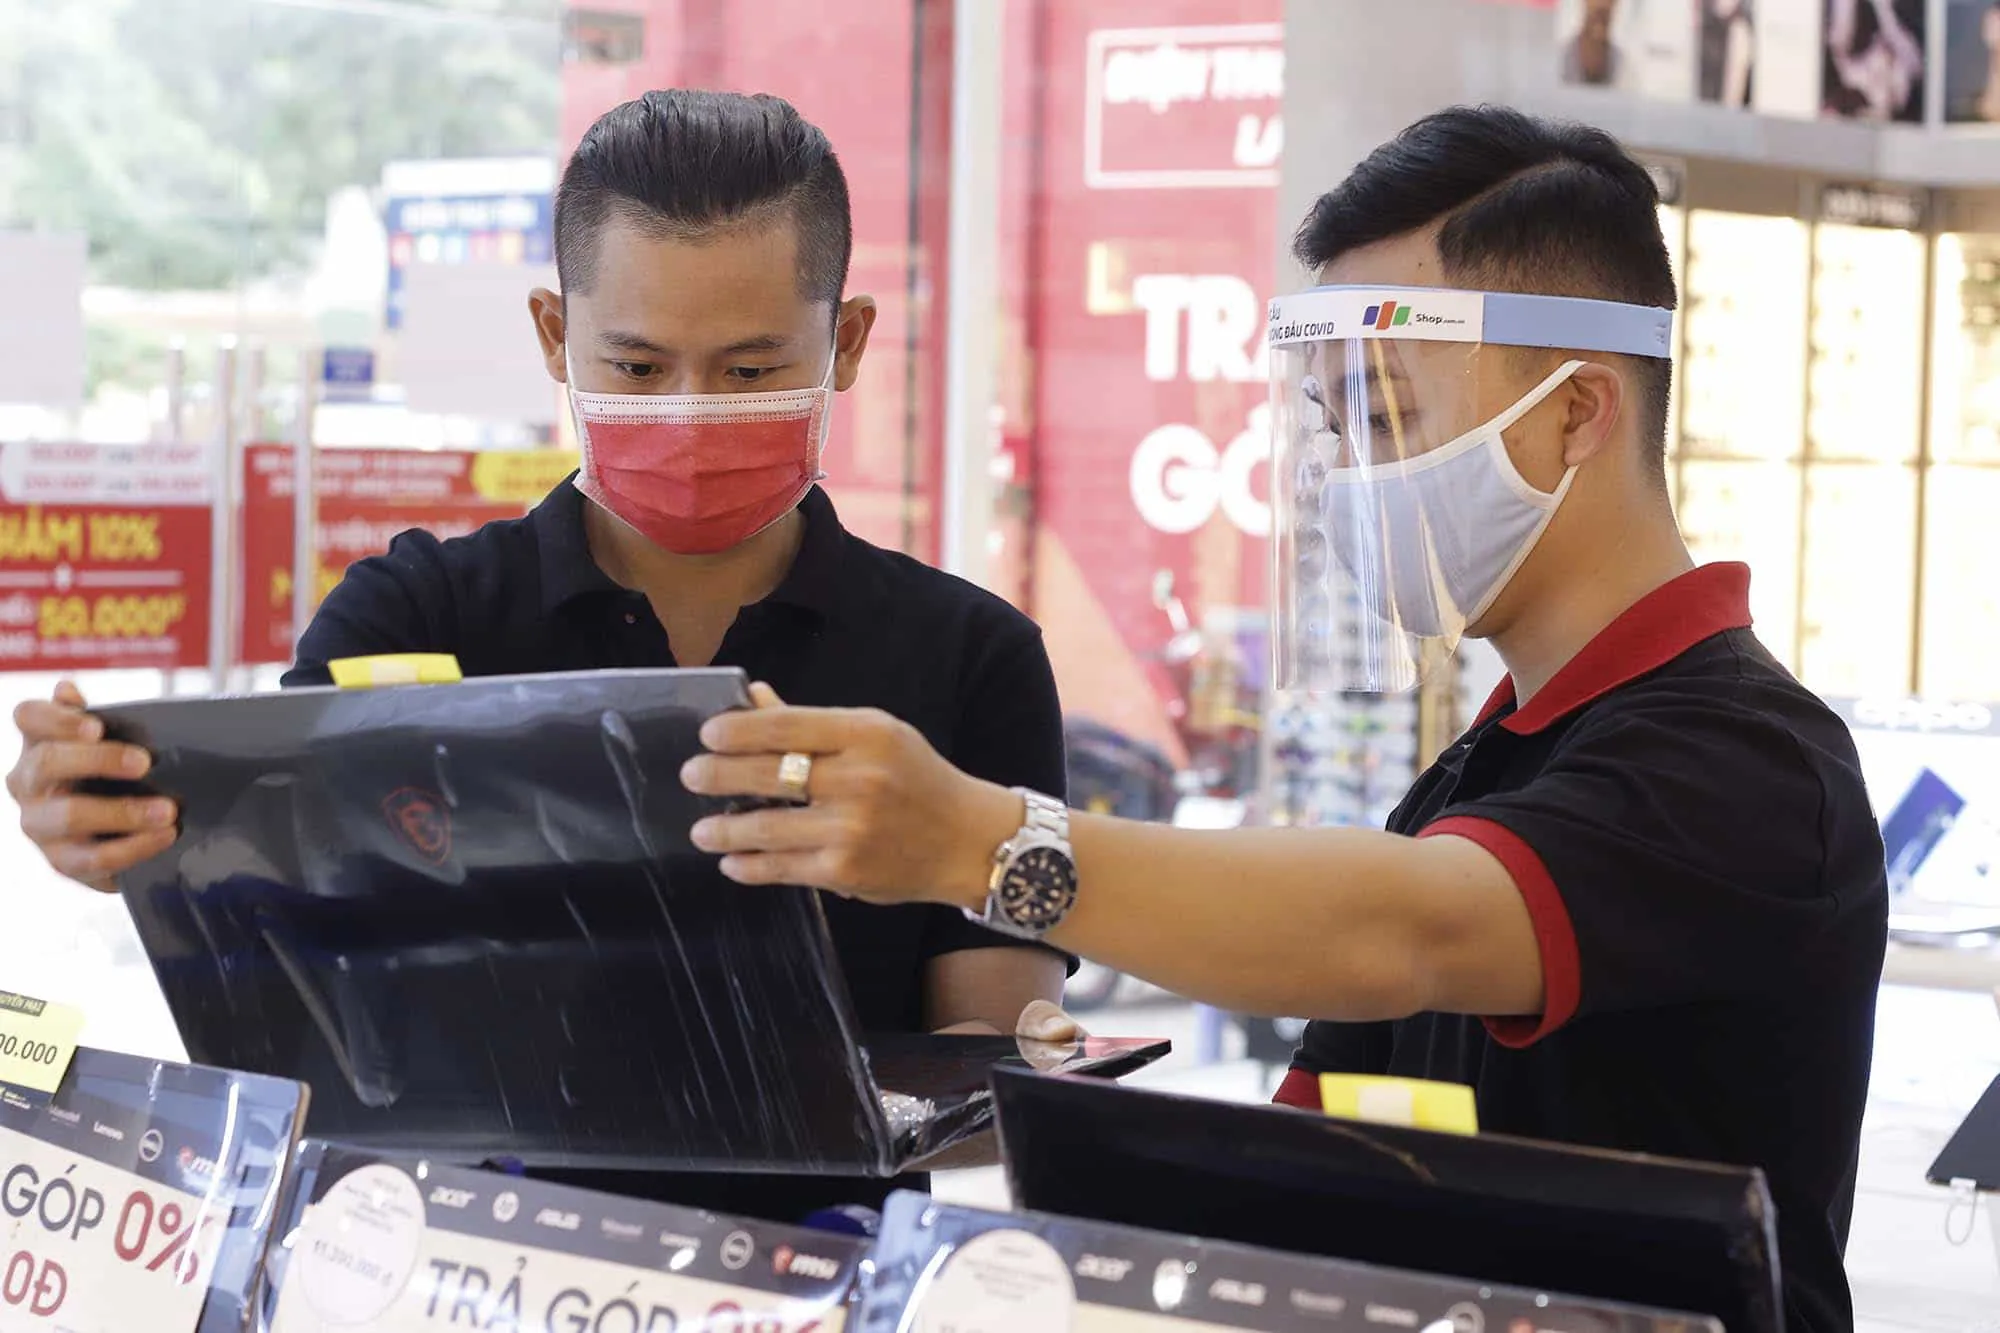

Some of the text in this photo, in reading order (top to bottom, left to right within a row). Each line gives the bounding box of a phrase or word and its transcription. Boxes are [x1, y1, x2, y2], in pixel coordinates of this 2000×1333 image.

[1303, 321, 1335, 337] COVID
[2, 1163, 212, 1284] GÓP 0%
[3, 1250, 68, 1316] 0Đ
[427, 1256, 522, 1333] TRẢ
